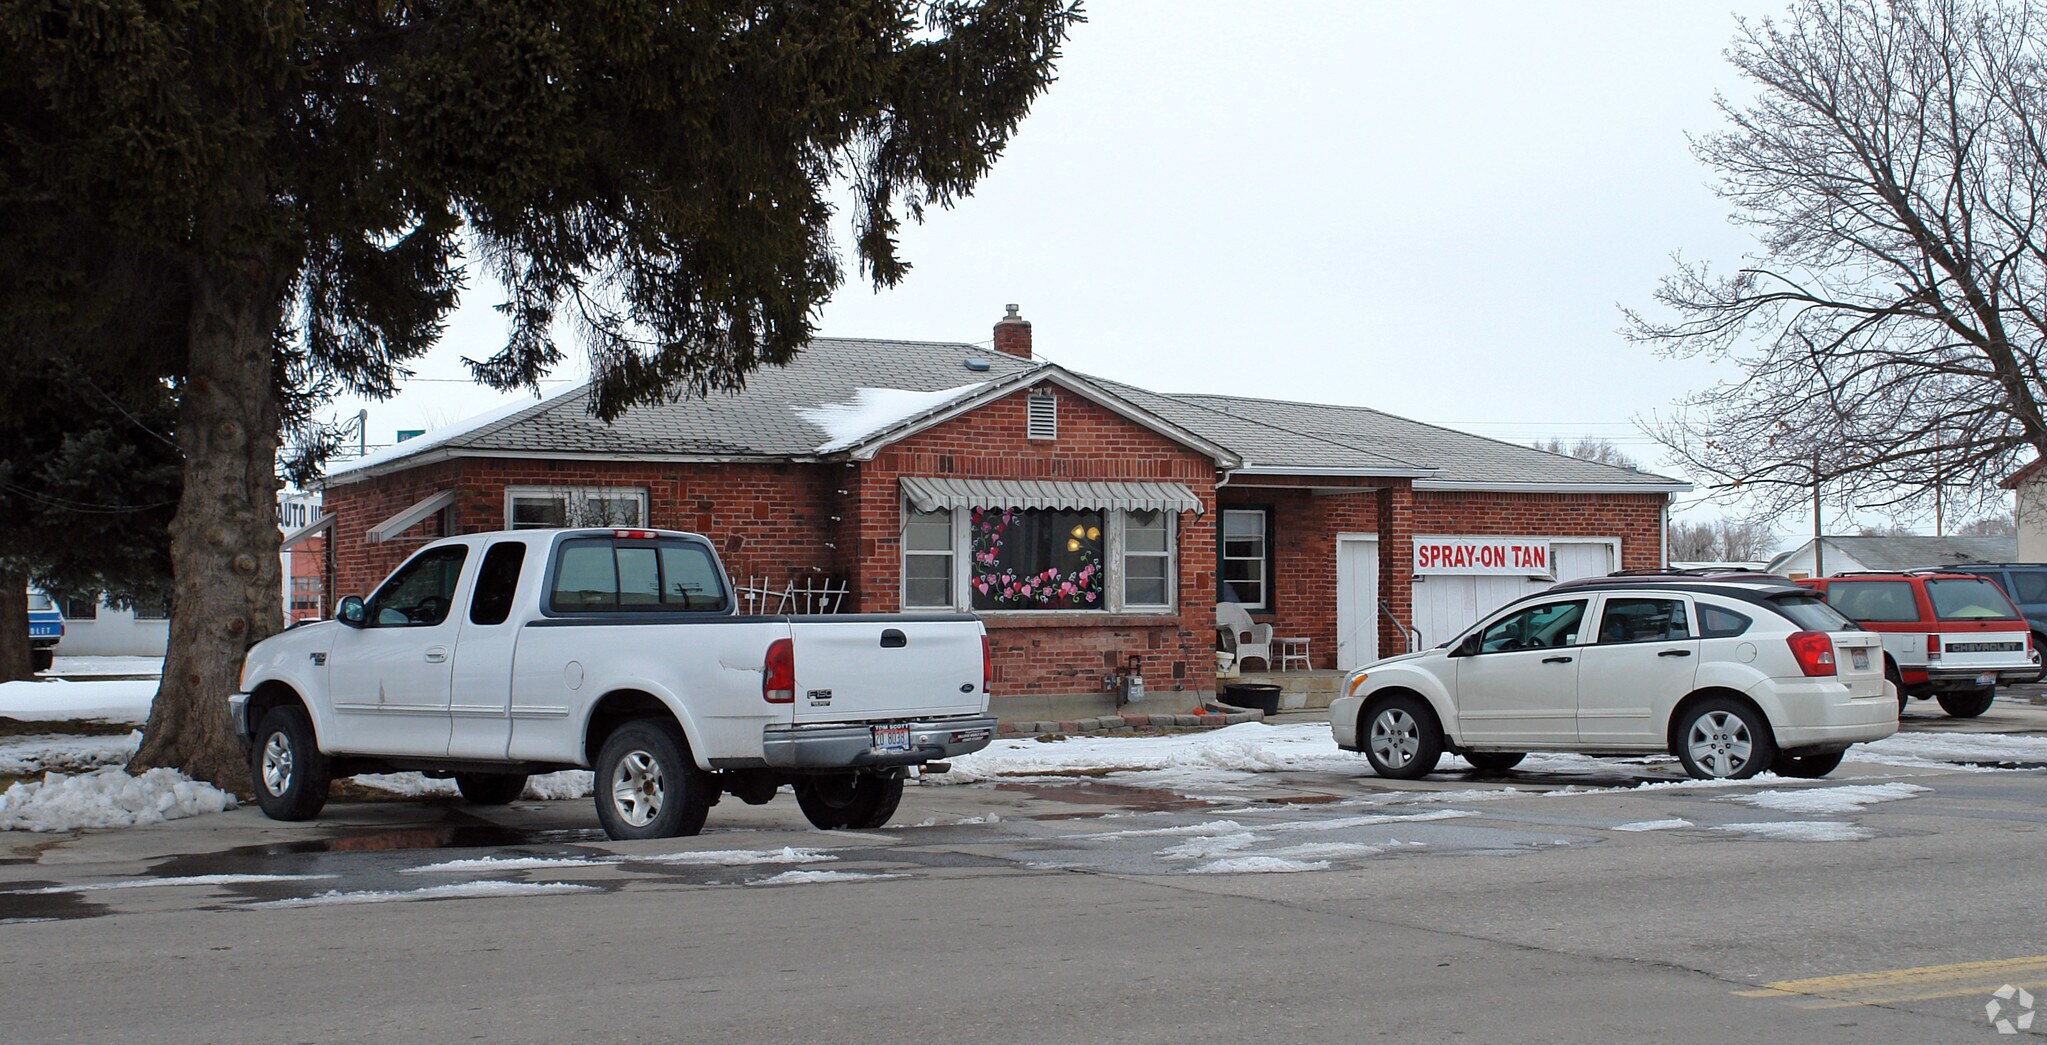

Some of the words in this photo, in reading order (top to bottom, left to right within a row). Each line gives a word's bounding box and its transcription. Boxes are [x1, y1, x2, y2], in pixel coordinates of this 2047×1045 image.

[276, 503, 306, 528] AUTO
[1418, 544, 1506, 568] SPRAY-ON
[1511, 545, 1546, 568] TAN
[1952, 643, 2017, 652] CHEVROLET
